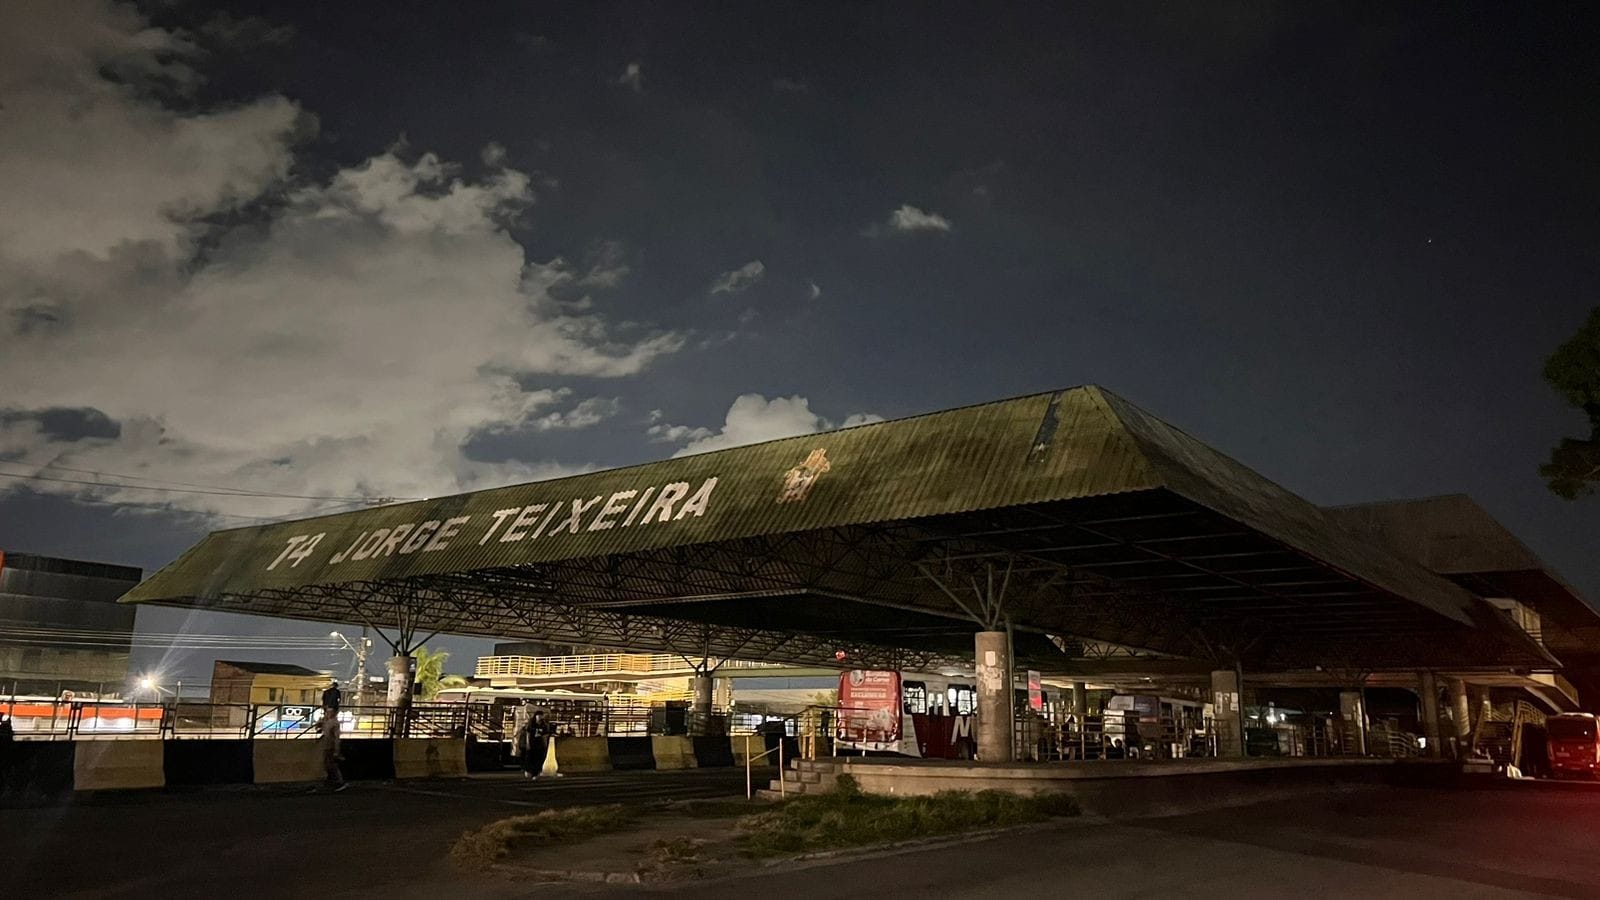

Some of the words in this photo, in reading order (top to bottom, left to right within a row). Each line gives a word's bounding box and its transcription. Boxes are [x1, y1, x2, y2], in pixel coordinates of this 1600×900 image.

[266, 532, 326, 571] T4
[329, 515, 472, 565] JORGE
[478, 476, 718, 546] TEIXEIRA
